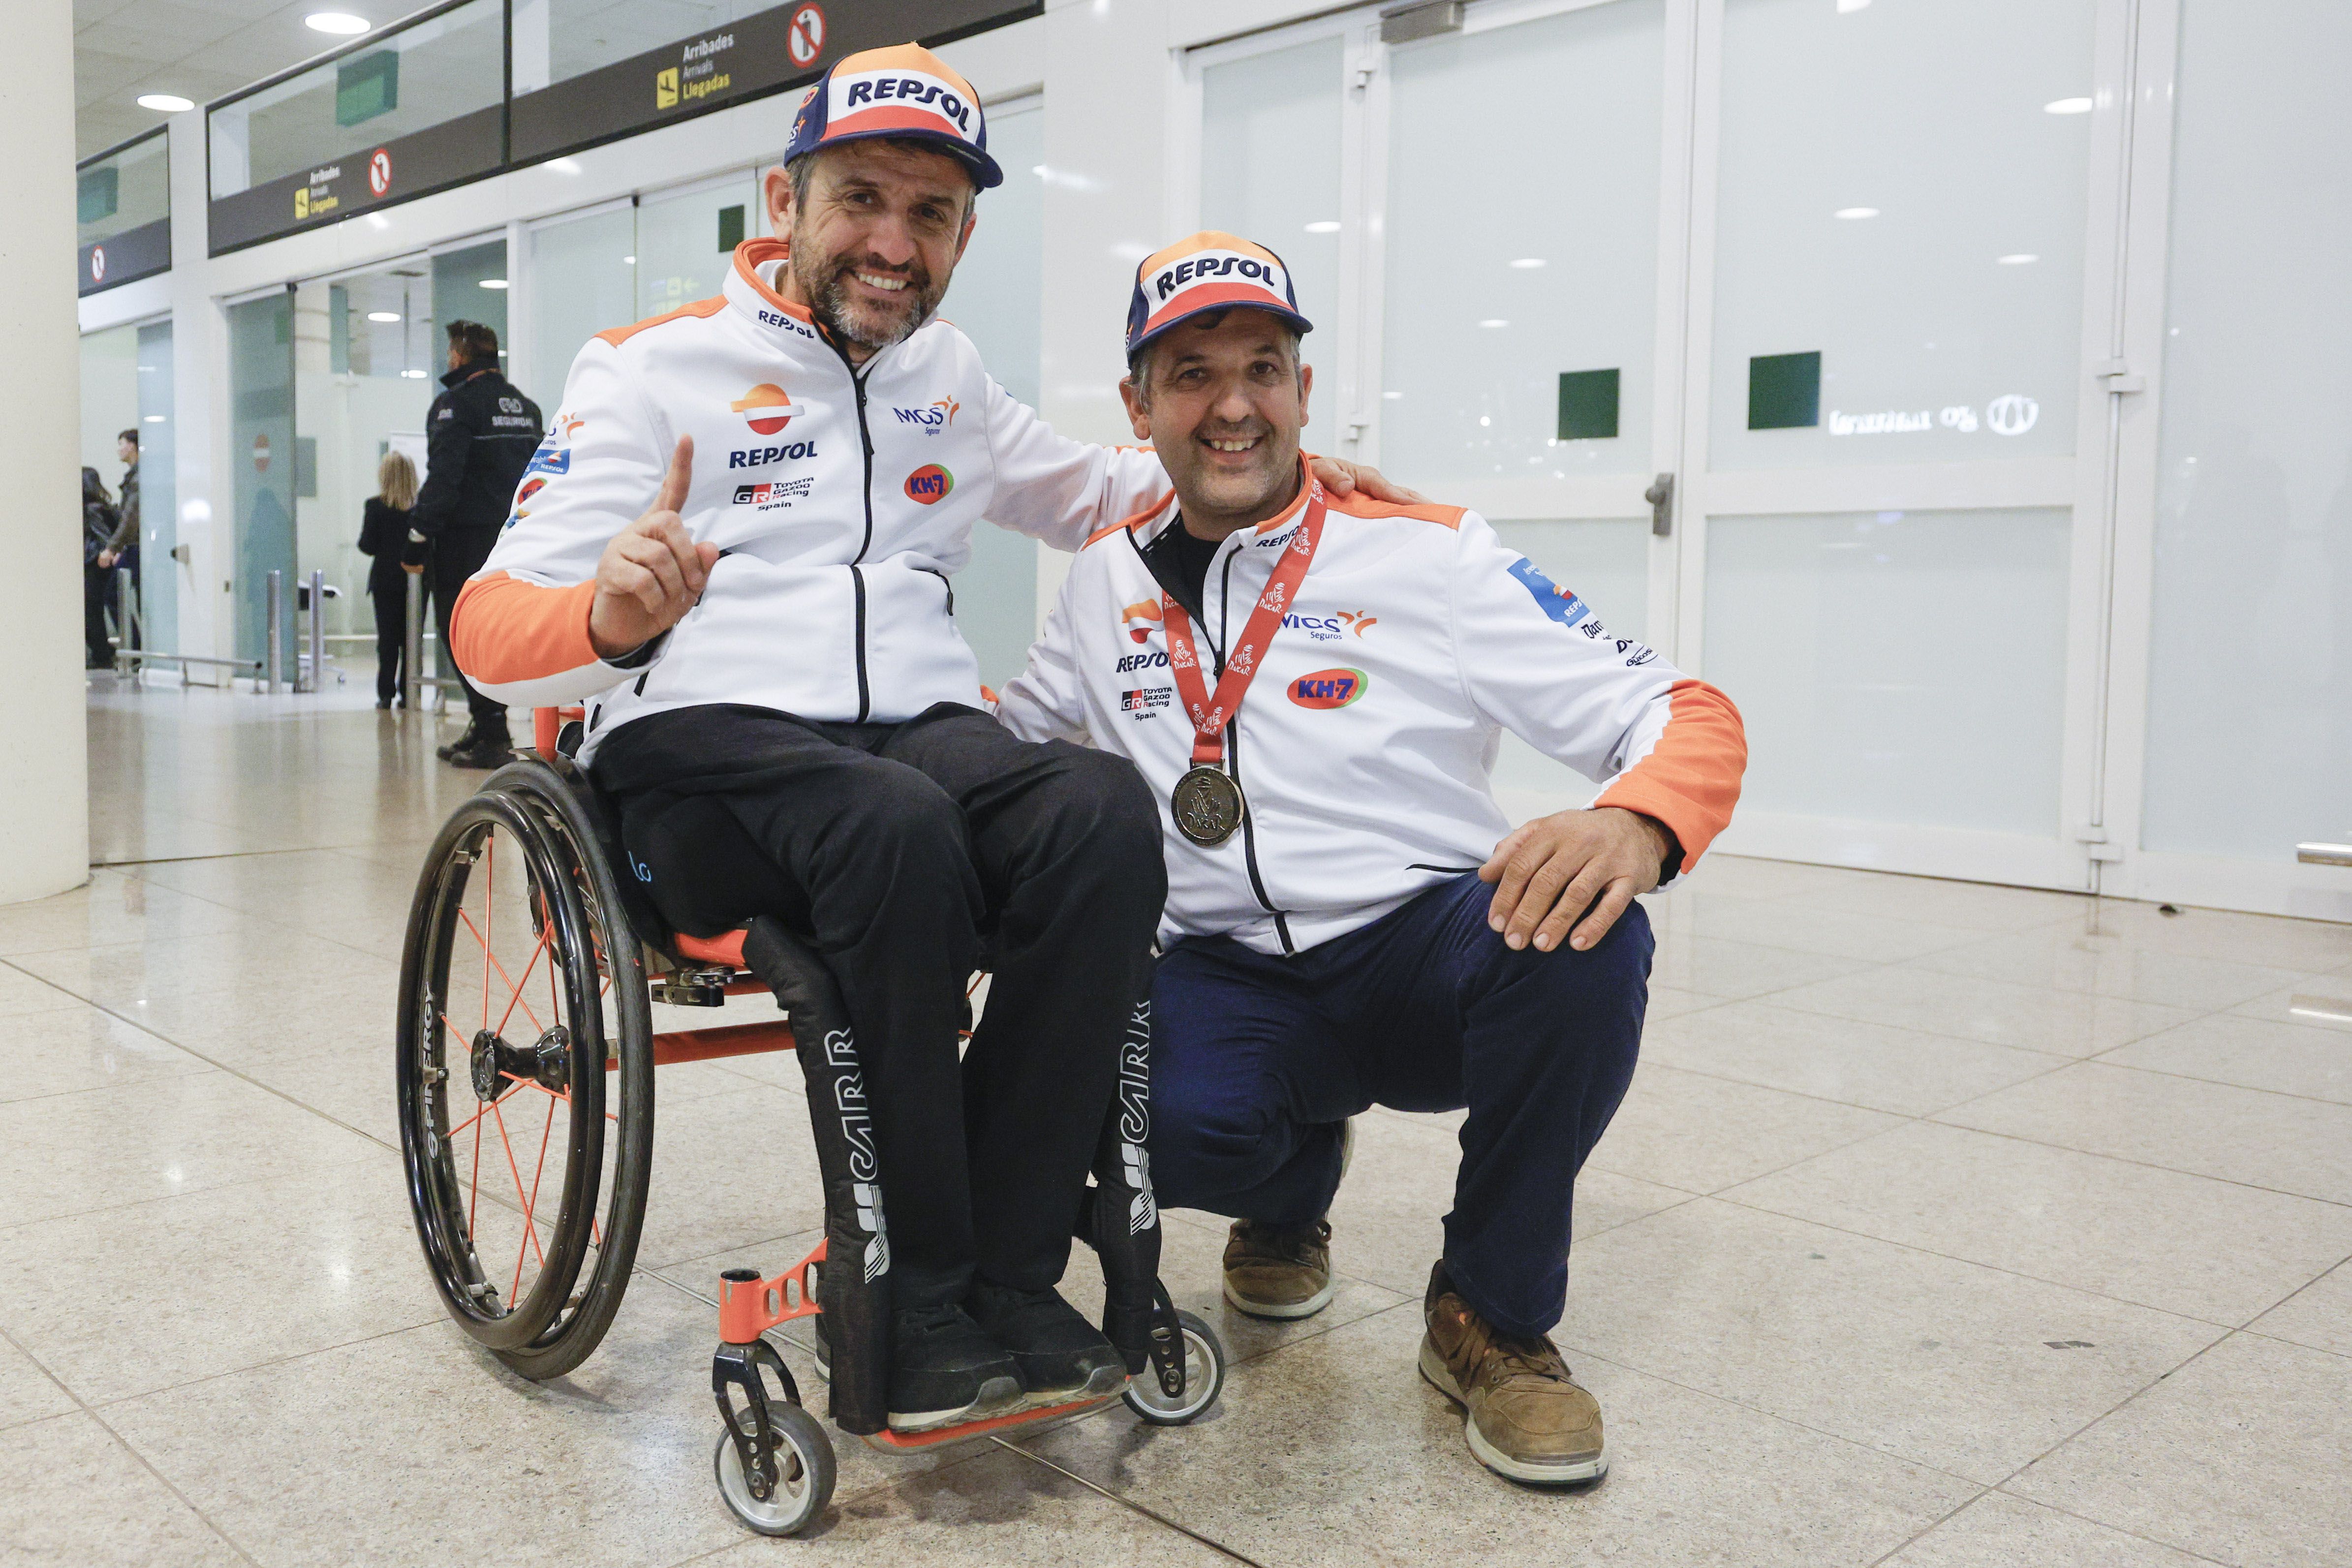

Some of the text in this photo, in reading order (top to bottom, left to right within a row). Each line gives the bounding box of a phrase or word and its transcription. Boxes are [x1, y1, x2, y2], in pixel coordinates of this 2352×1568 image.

[683, 34, 734, 62] Arribades
[683, 59, 713, 80] Arrivals
[683, 74, 730, 99] Llegadas
[848, 78, 969, 132] REPSOL
[1157, 257, 1274, 300] REPSOL
[892, 407, 944, 425] MGS
[729, 441, 818, 468] REPSOL
[540, 463, 564, 472] REPSOL
[773, 483, 810, 495] GAZOO
[774, 477, 814, 489] TOYOTA
[734, 492, 770, 504] GR
[1256, 525, 1300, 547] REPSO
[1310, 631, 1342, 641] Seguros
[1116, 651, 1171, 673] REPSO
[1174, 657, 1196, 670] DAKAR
[1122, 698, 1142, 710] GR
[1135, 711, 1156, 721] Spain
